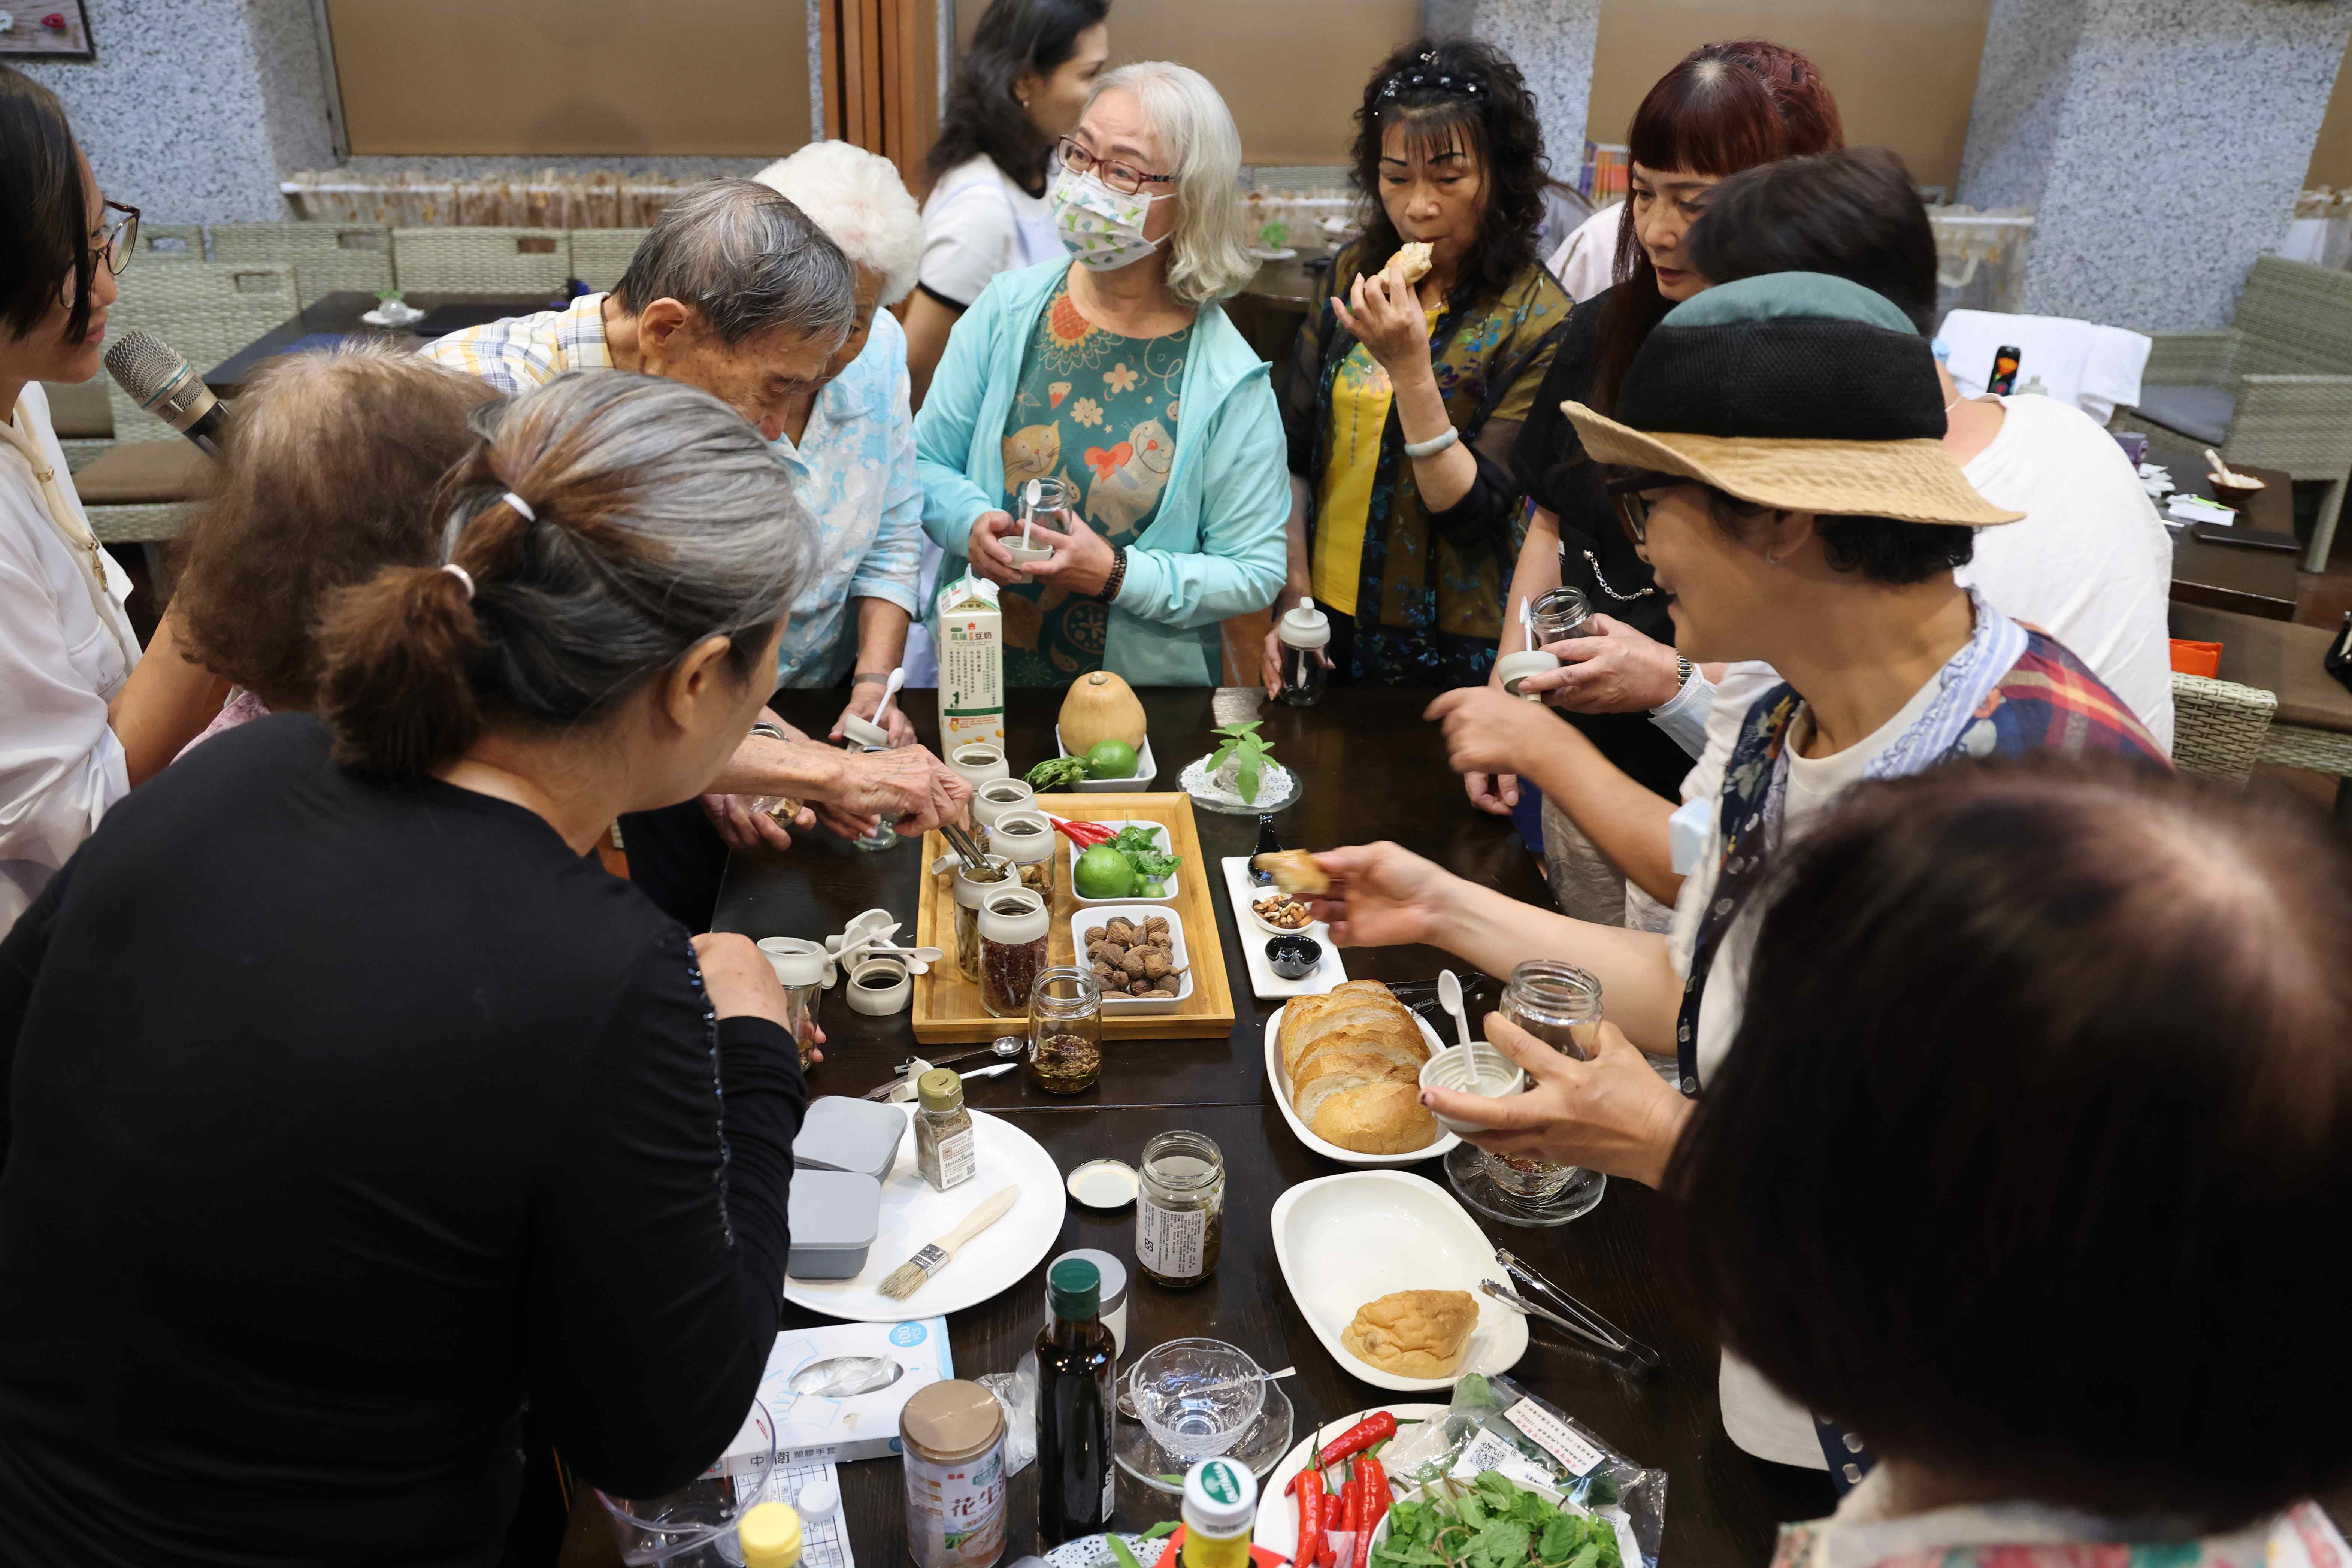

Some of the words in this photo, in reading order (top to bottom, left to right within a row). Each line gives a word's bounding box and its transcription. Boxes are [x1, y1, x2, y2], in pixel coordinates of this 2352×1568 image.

[898, 1326, 911, 1344] 100
[912, 1327, 921, 1340] PCS
[794, 1446, 836, 1458] 塑膠手套
[779, 1485, 792, 1507] 南瓜
